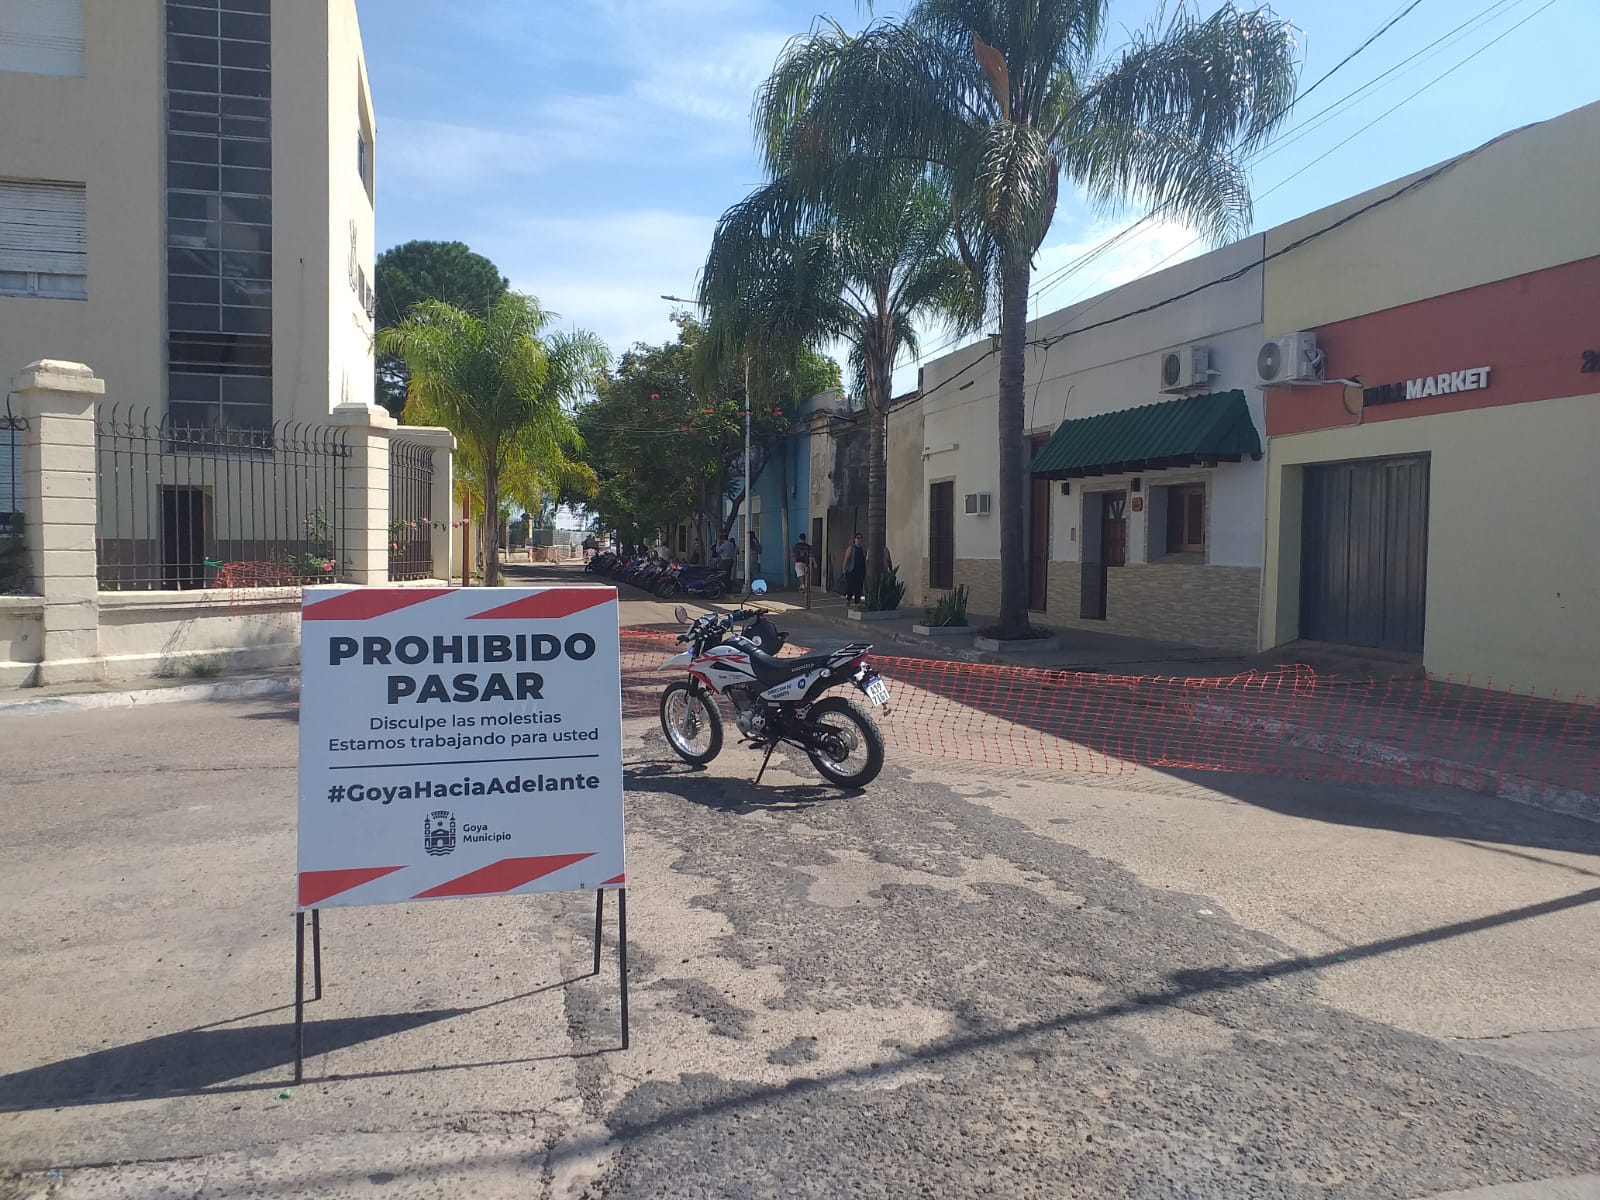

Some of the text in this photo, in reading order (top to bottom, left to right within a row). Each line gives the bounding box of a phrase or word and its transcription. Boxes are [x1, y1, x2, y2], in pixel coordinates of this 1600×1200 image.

[1406, 366, 1491, 400] MARKET
[329, 632, 596, 666] PROHIBIDO
[387, 672, 545, 704] PASAR
[370, 711, 562, 732] Disculpe las molestias
[329, 728, 599, 751] Estamos trabajando para usted
[328, 773, 600, 805] #GoyaHaciaAdelante
[463, 823, 488, 834] Goya
[463, 832, 512, 843] Municipio
